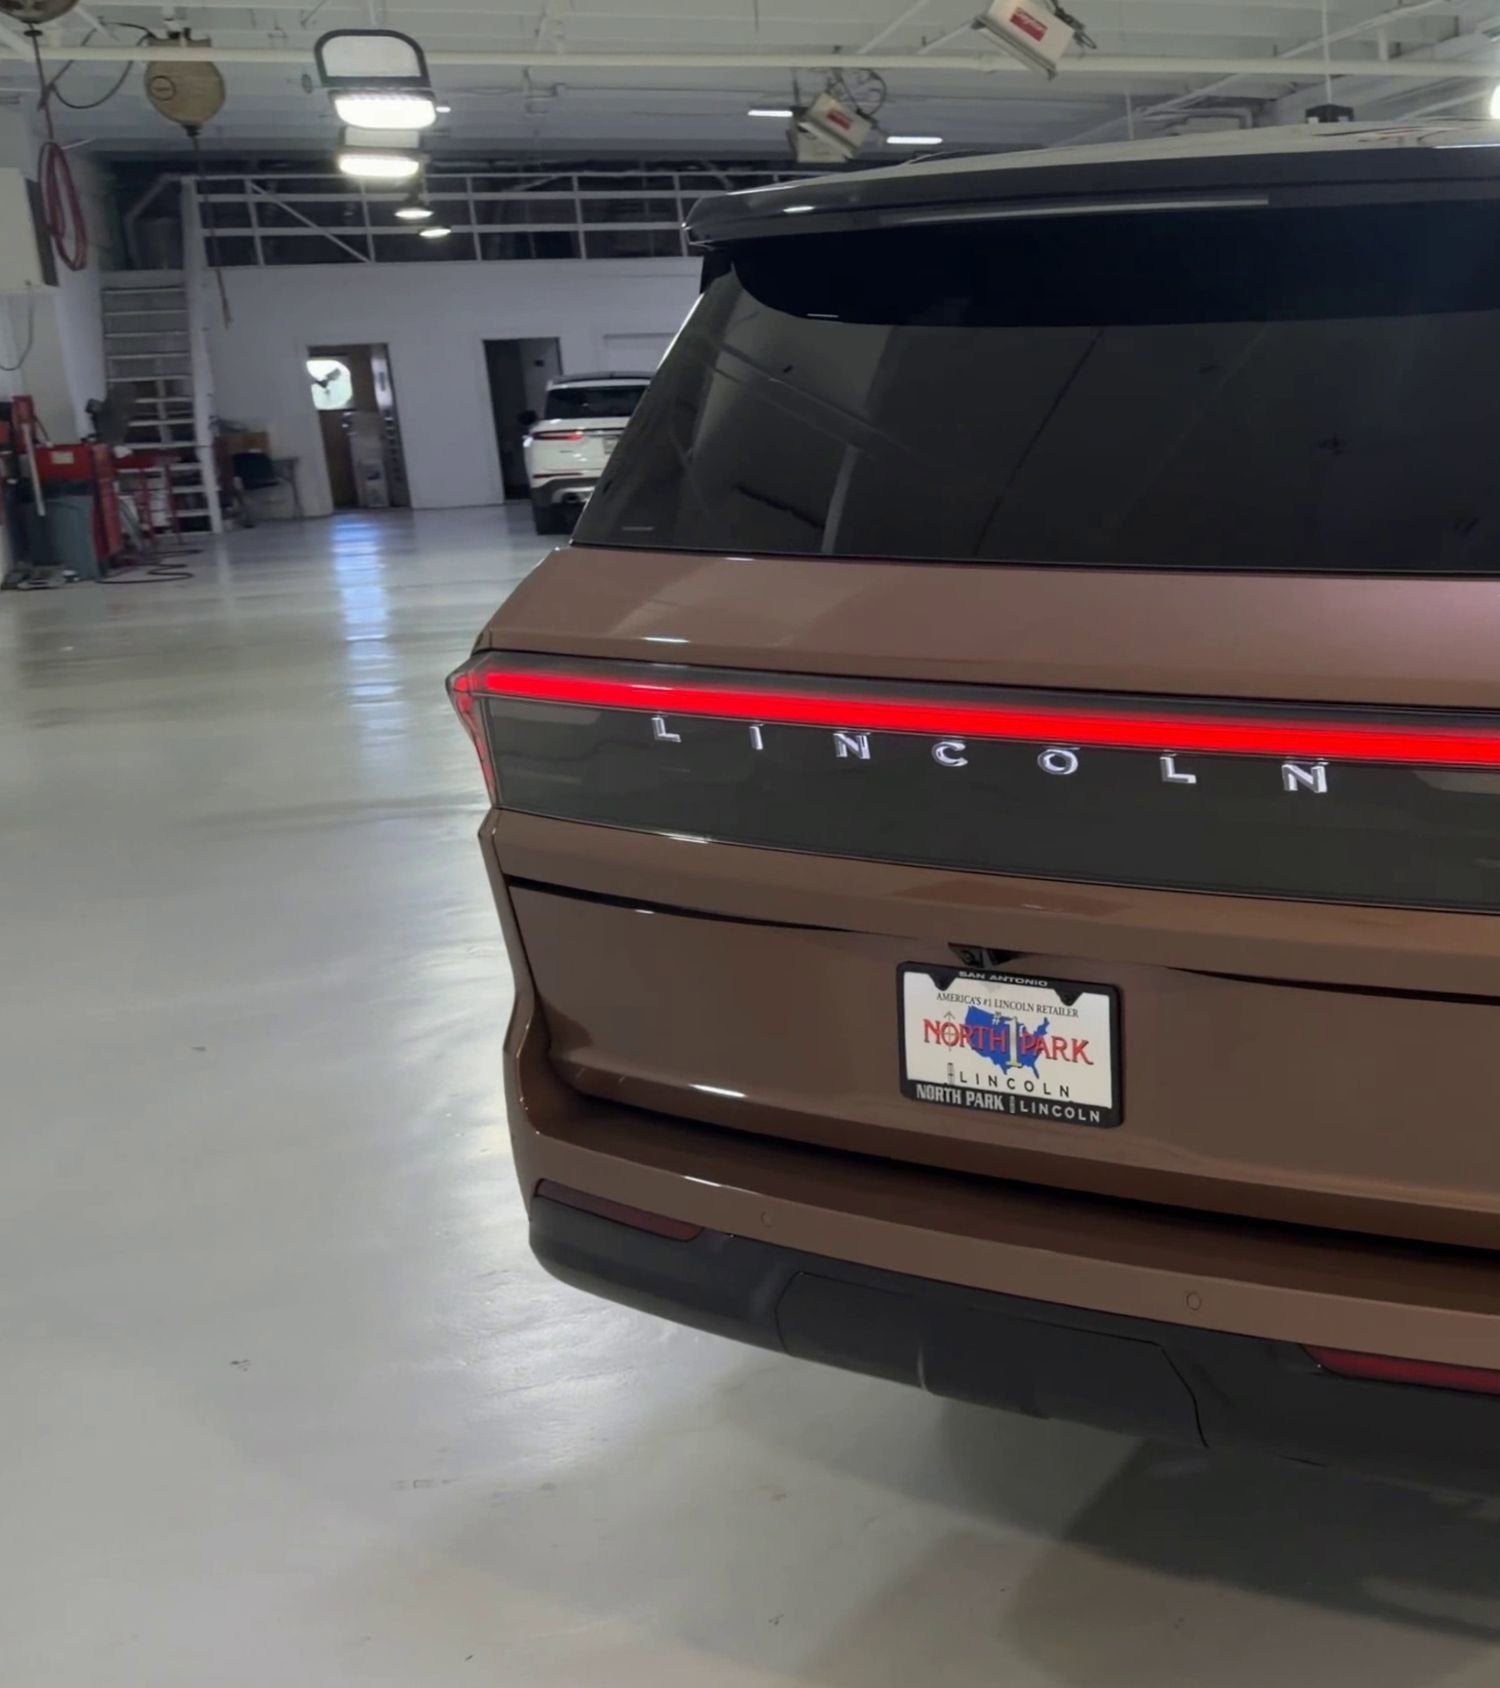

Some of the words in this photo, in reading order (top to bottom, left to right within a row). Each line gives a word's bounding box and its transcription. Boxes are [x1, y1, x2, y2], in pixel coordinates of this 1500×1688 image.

[650, 712, 1329, 793] LINCOLN
[958, 970, 986, 980] SAN
[989, 974, 1049, 987] ANTONIO
[936, 992, 982, 1006] AMERICA'S
[994, 999, 1035, 1014] LINCOLN
[1036, 1003, 1079, 1018] RETAILER
[923, 1018, 1007, 1053] NORTH
[1020, 1032, 1094, 1066] PARK
[959, 1071, 1071, 1098] LINCOLN
[916, 1083, 962, 1105] NORTH
[966, 1090, 1005, 1111] PARK
[1020, 1100, 1101, 1123] LINCOLN
